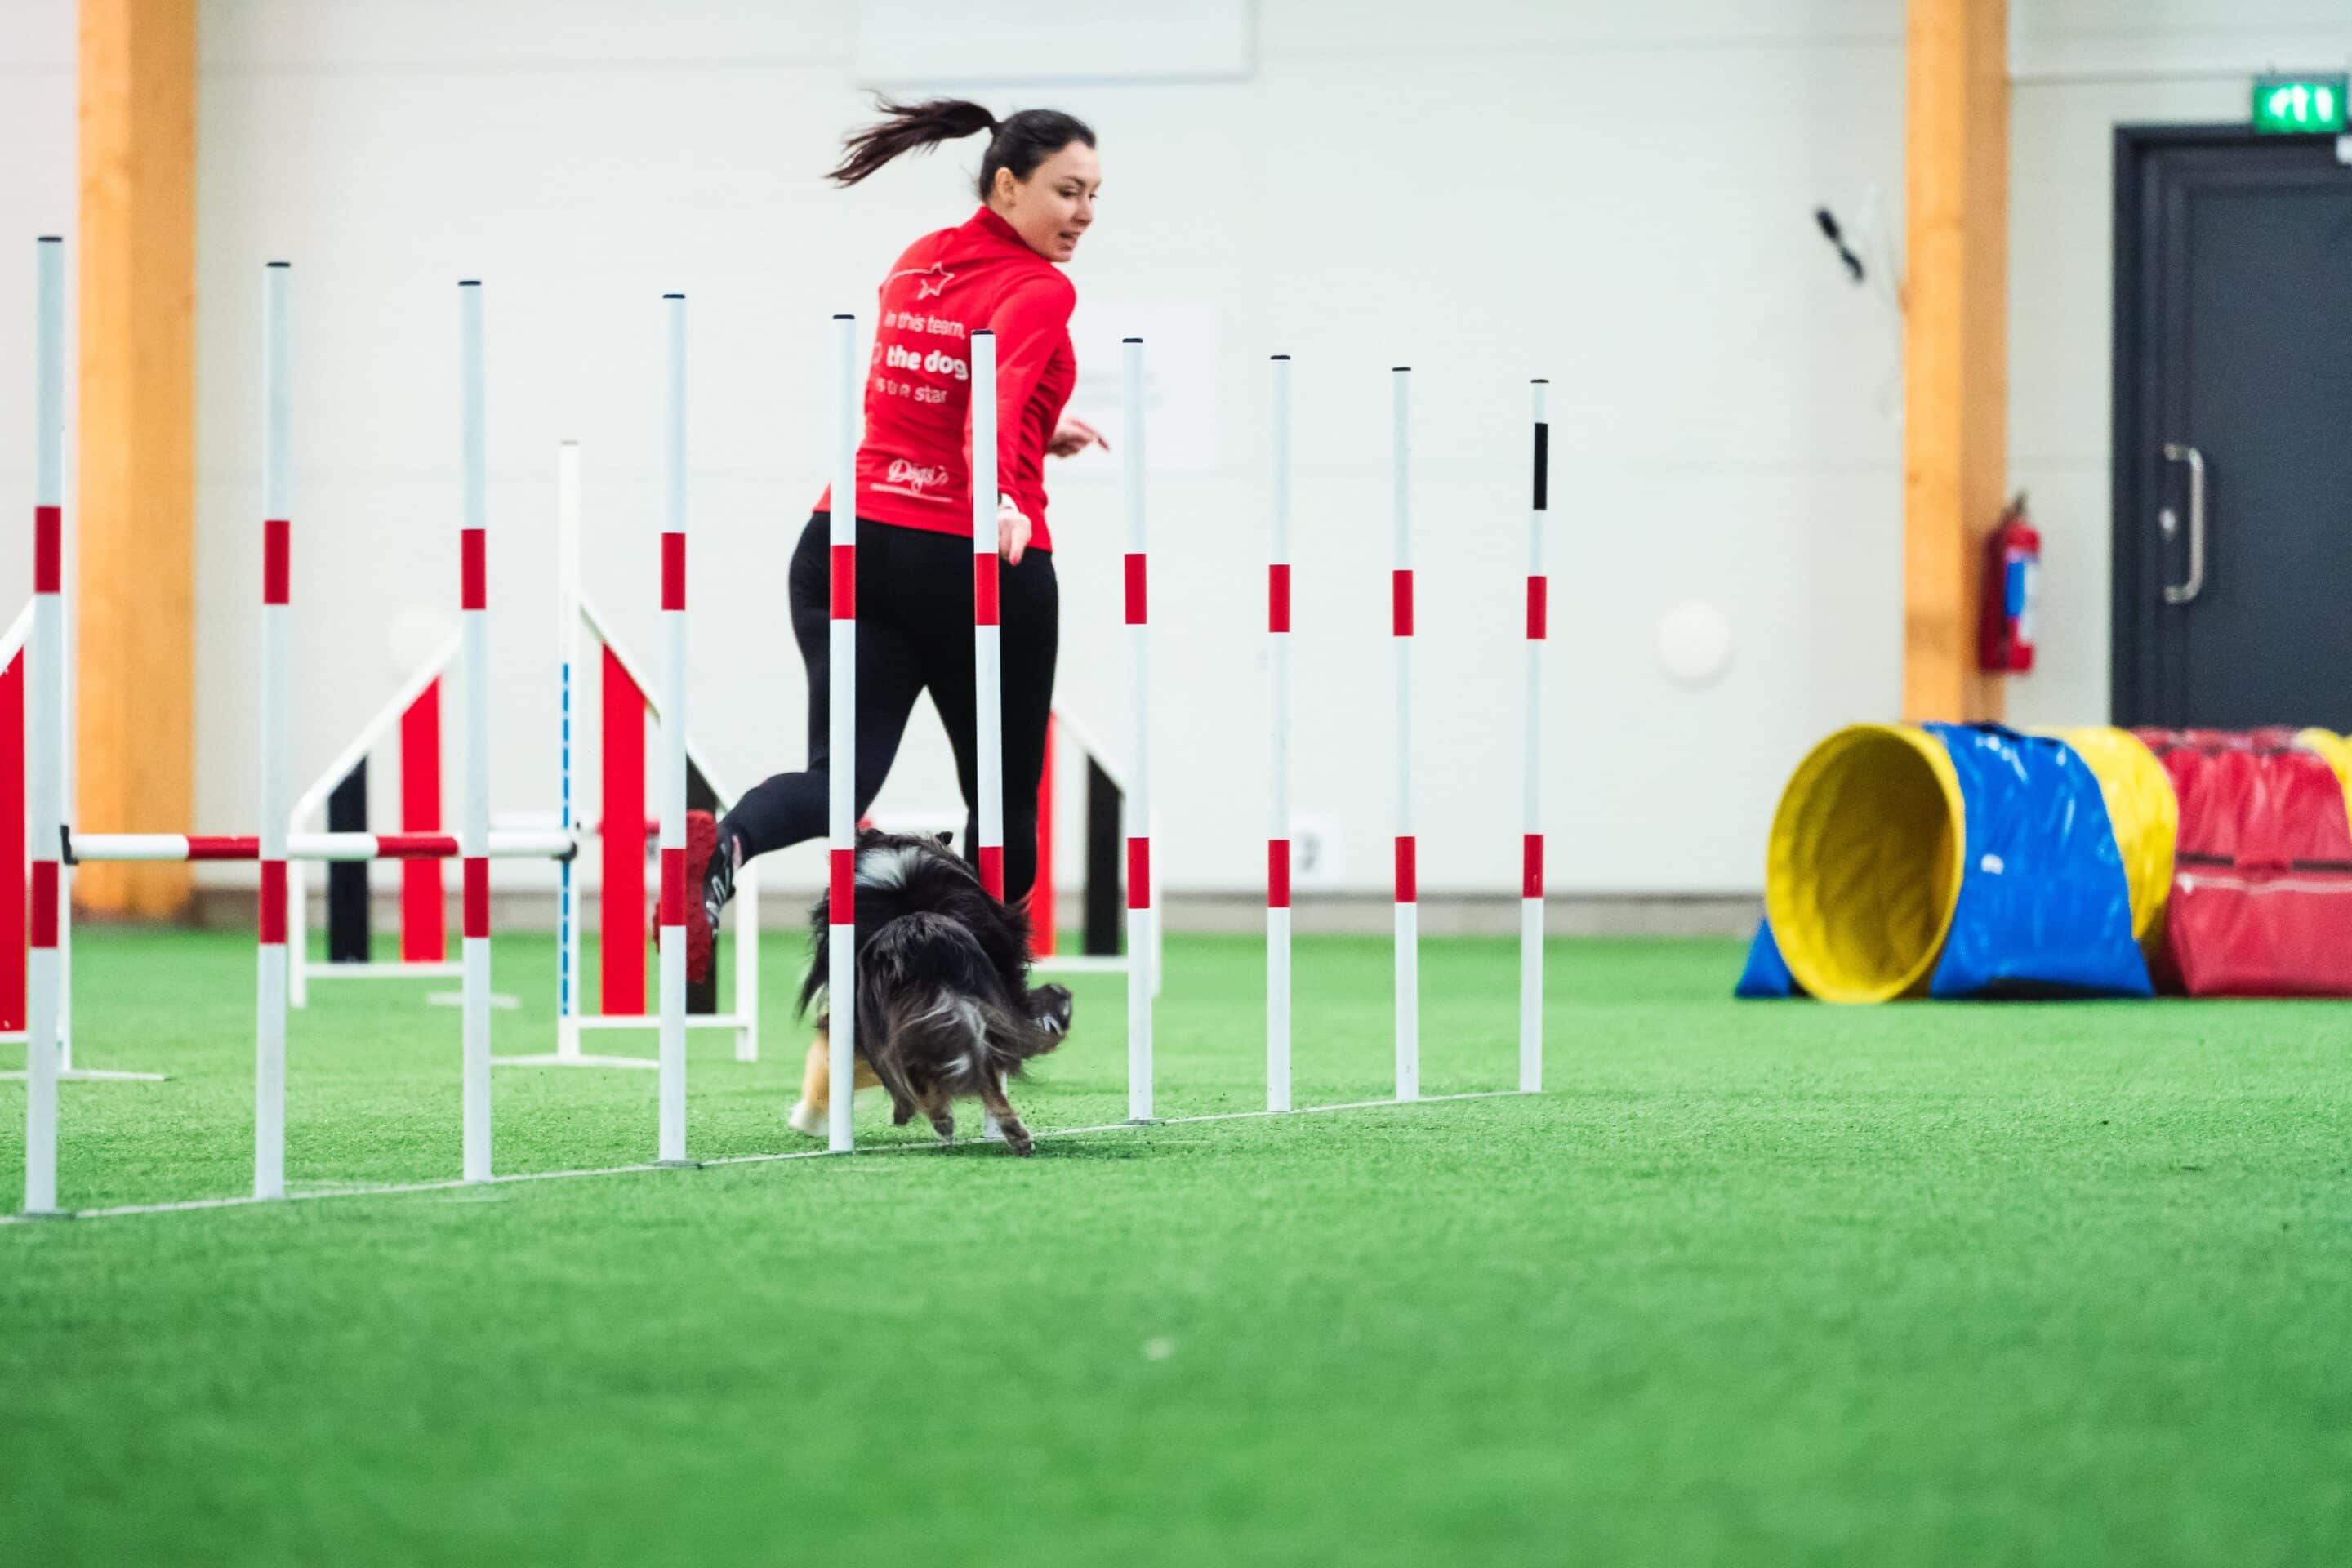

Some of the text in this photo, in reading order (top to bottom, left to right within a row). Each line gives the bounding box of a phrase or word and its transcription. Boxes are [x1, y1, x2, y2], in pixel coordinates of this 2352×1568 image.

[898, 311, 924, 332] this
[887, 345, 969, 381] the dog
[914, 385, 948, 403] star
